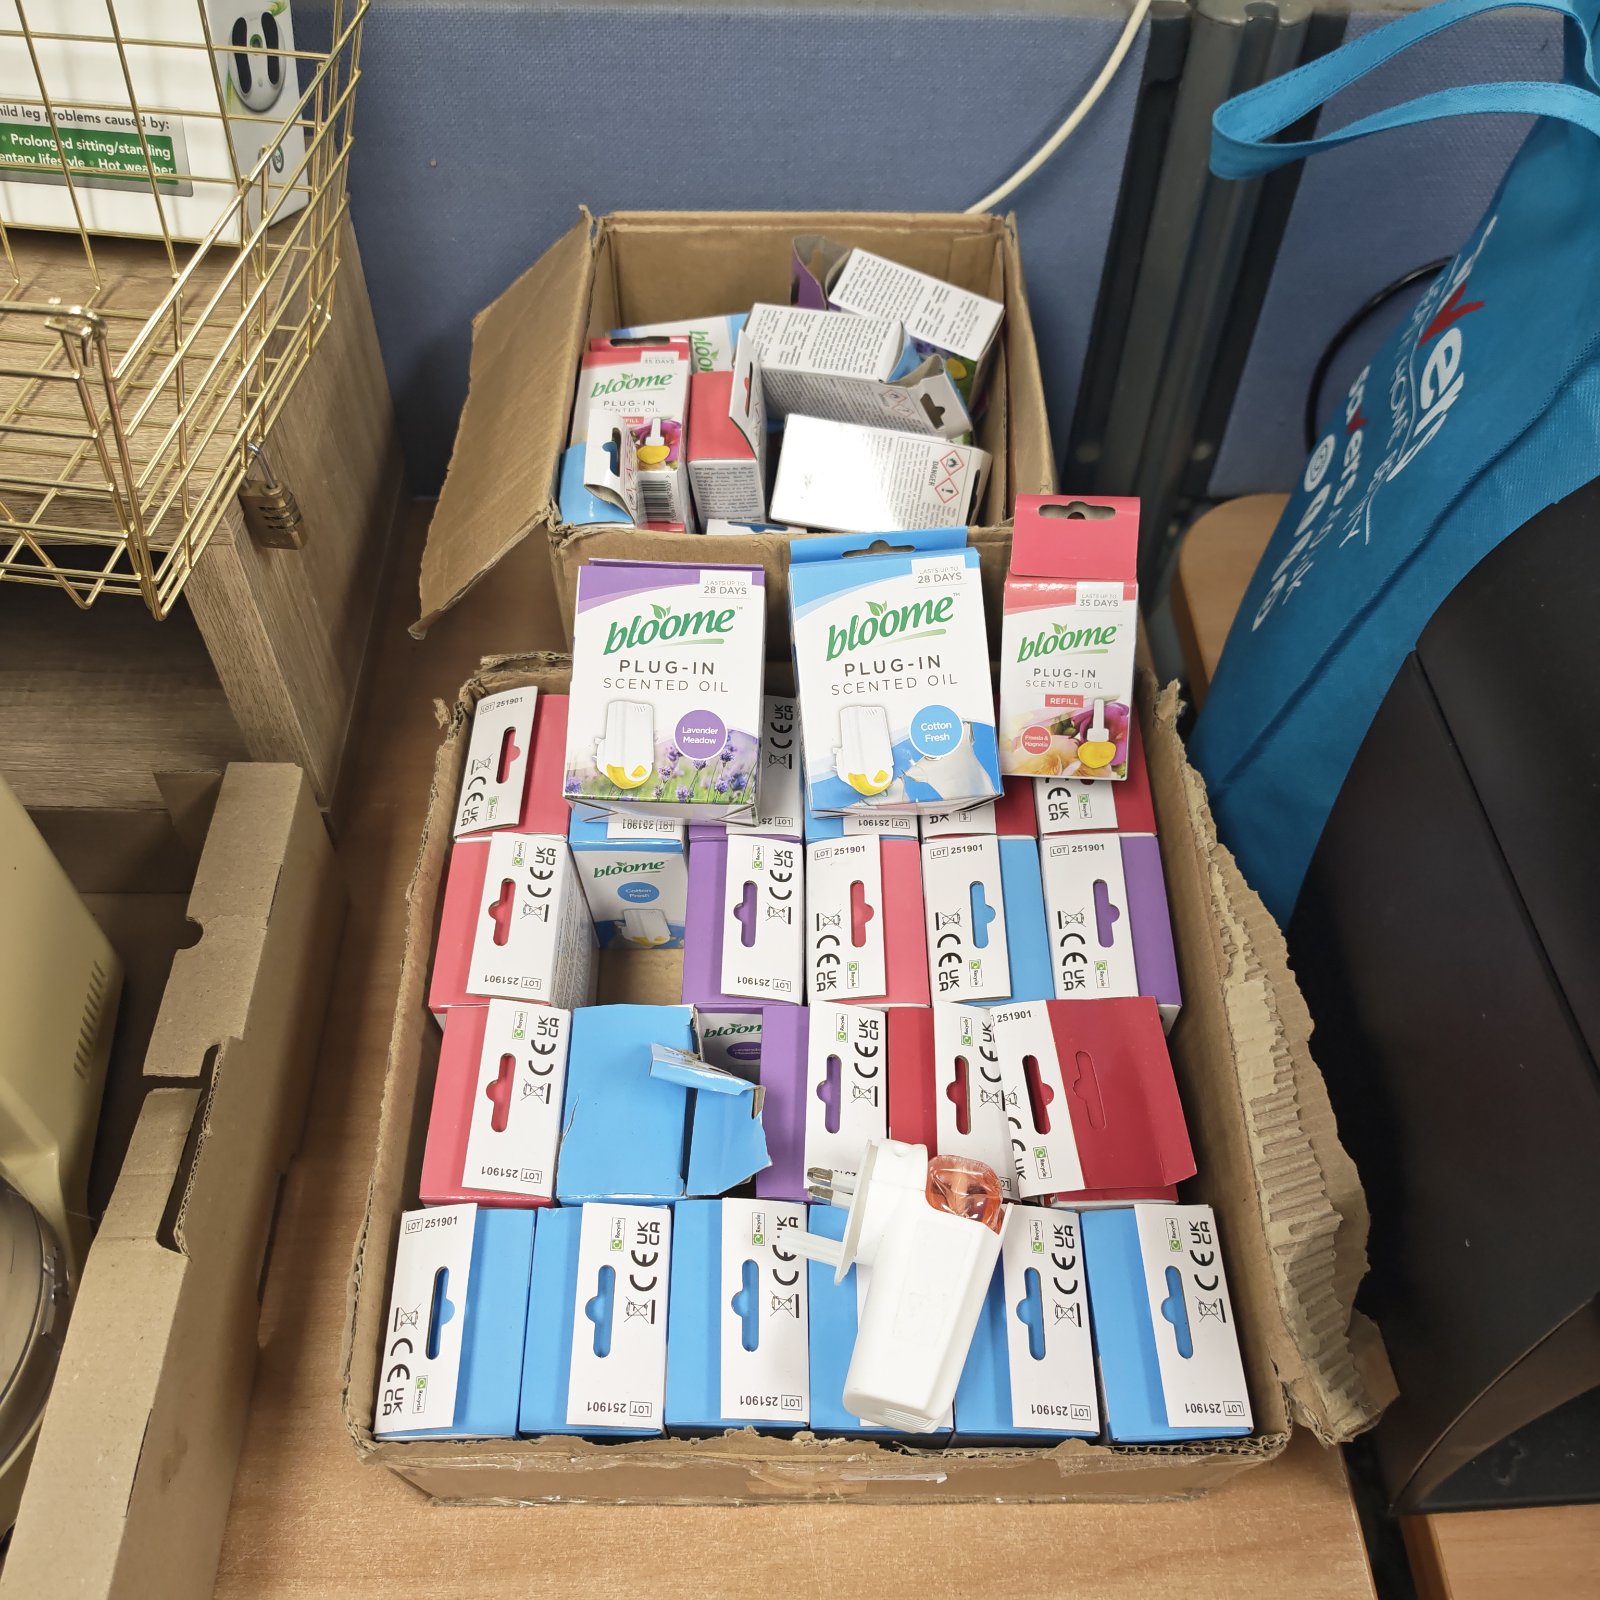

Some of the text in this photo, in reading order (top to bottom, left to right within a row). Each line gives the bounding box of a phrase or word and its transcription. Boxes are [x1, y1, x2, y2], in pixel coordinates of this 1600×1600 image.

[21, 106, 40, 122] leg
[150, 116, 170, 132] by:
[590, 374, 673, 398] bloome
[927, 460, 940, 487] DANGER
[917, 572, 962, 584] 28 DAYS
[703, 585, 747, 595] 28 DAYS
[1079, 599, 1119, 607] 35 DAYS
[602, 606, 736, 656] bloome
[825, 595, 954, 662] bloome
[1016, 623, 1118, 664] bloome
[619, 659, 715, 676] PLUG-IN
[844, 654, 942, 677] PLUG-IN
[1033, 668, 1097, 679] PLUG-IN
[603, 677, 729, 693] SCENTED OIL
[831, 674, 959, 696] SCENTED OIL
[1025, 679, 1103, 690] SCENTED OIL
[481, 697, 524, 713] LOT 251901
[1050, 697, 1079, 705] REFILL
[681, 726, 719, 735] Lavender
[920, 721, 952, 731] Cotton
[682, 736, 717, 745] Meadow
[770, 721, 793, 749] CE
[924, 732, 950, 743] Fresh
[464, 775, 487, 806] CE
[858, 819, 890, 827] 251901
[816, 845, 866, 859] LOT 251901
[932, 843, 983, 857] LOT 251901
[1052, 843, 1105, 855] LOT 251901
[593, 860, 666, 879] bloome
[527, 866, 554, 898] CE
[768, 869, 793, 900] CE
[816, 934, 841, 968] CE
[937, 933, 963, 968] CE
[1060, 932, 1088, 967] CE
[484, 974, 539, 988] LOT 251901
[737, 976, 789, 989] LOT 251901
[996, 1009, 1032, 1023] 251901
[528, 1039, 557, 1076] CE
[854, 1041, 879, 1079] CE
[481, 1166, 540, 1181] LOT 251901
[407, 1215, 458, 1232] LOT 251901
[614, 1219, 622, 1239] Recycle
[629, 1249, 659, 1292] CE
[1051, 1252, 1079, 1295] CE
[1189, 1250, 1219, 1291] CE
[386, 1337, 414, 1383] CE
[587, 1401, 650, 1415] LOT 251901
[739, 1395, 800, 1408] LOT 251901
[1184, 1403, 1243, 1414] LOT 251901
[1031, 1404, 1089, 1418] LOT 251901
